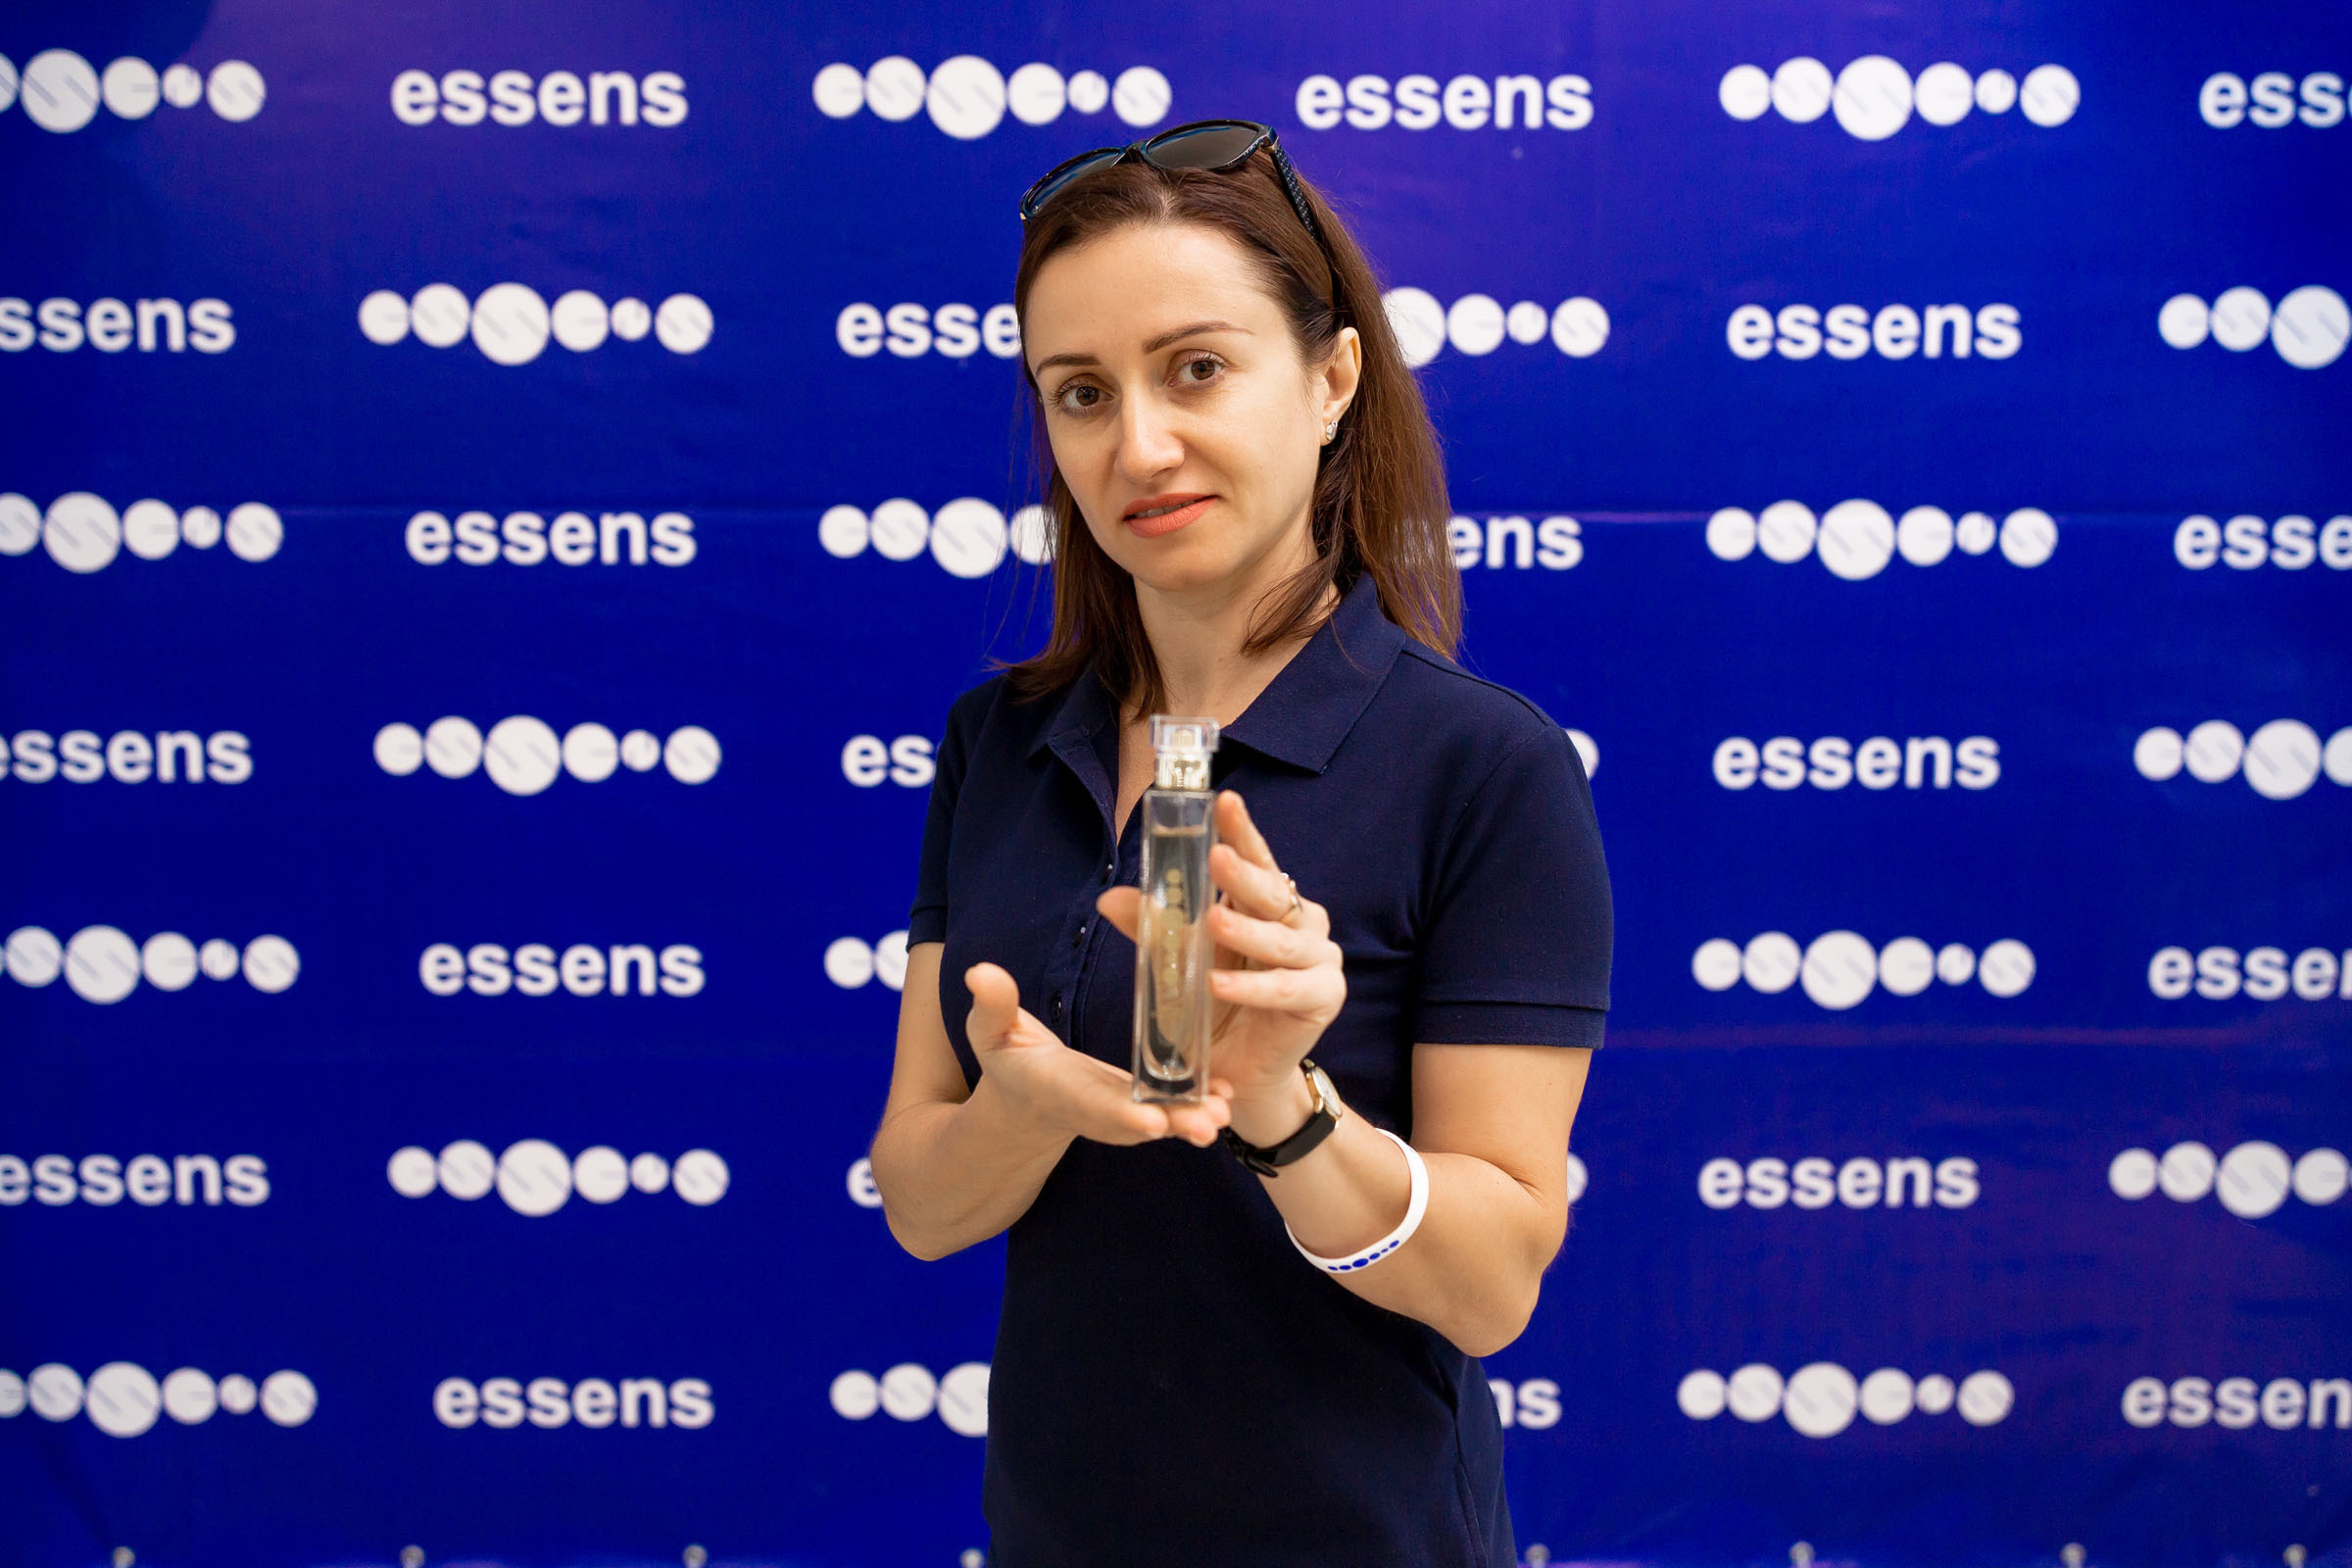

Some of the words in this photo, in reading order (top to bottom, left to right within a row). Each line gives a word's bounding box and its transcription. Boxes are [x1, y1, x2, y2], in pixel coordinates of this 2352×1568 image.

[390, 70, 688, 126] essens
[1295, 74, 1593, 130] essens
[2198, 73, 2352, 128] ess
[0, 297, 236, 354] ssens
[1726, 303, 2022, 360] essens
[405, 511, 696, 565] essens
[0, 730, 253, 784] ssens
[1712, 736, 1999, 790] essens
[419, 944, 705, 997] essens
[0, 1154, 270, 1206] essens
[1697, 1157, 1978, 1208] essens
[434, 1377, 713, 1428] essens
